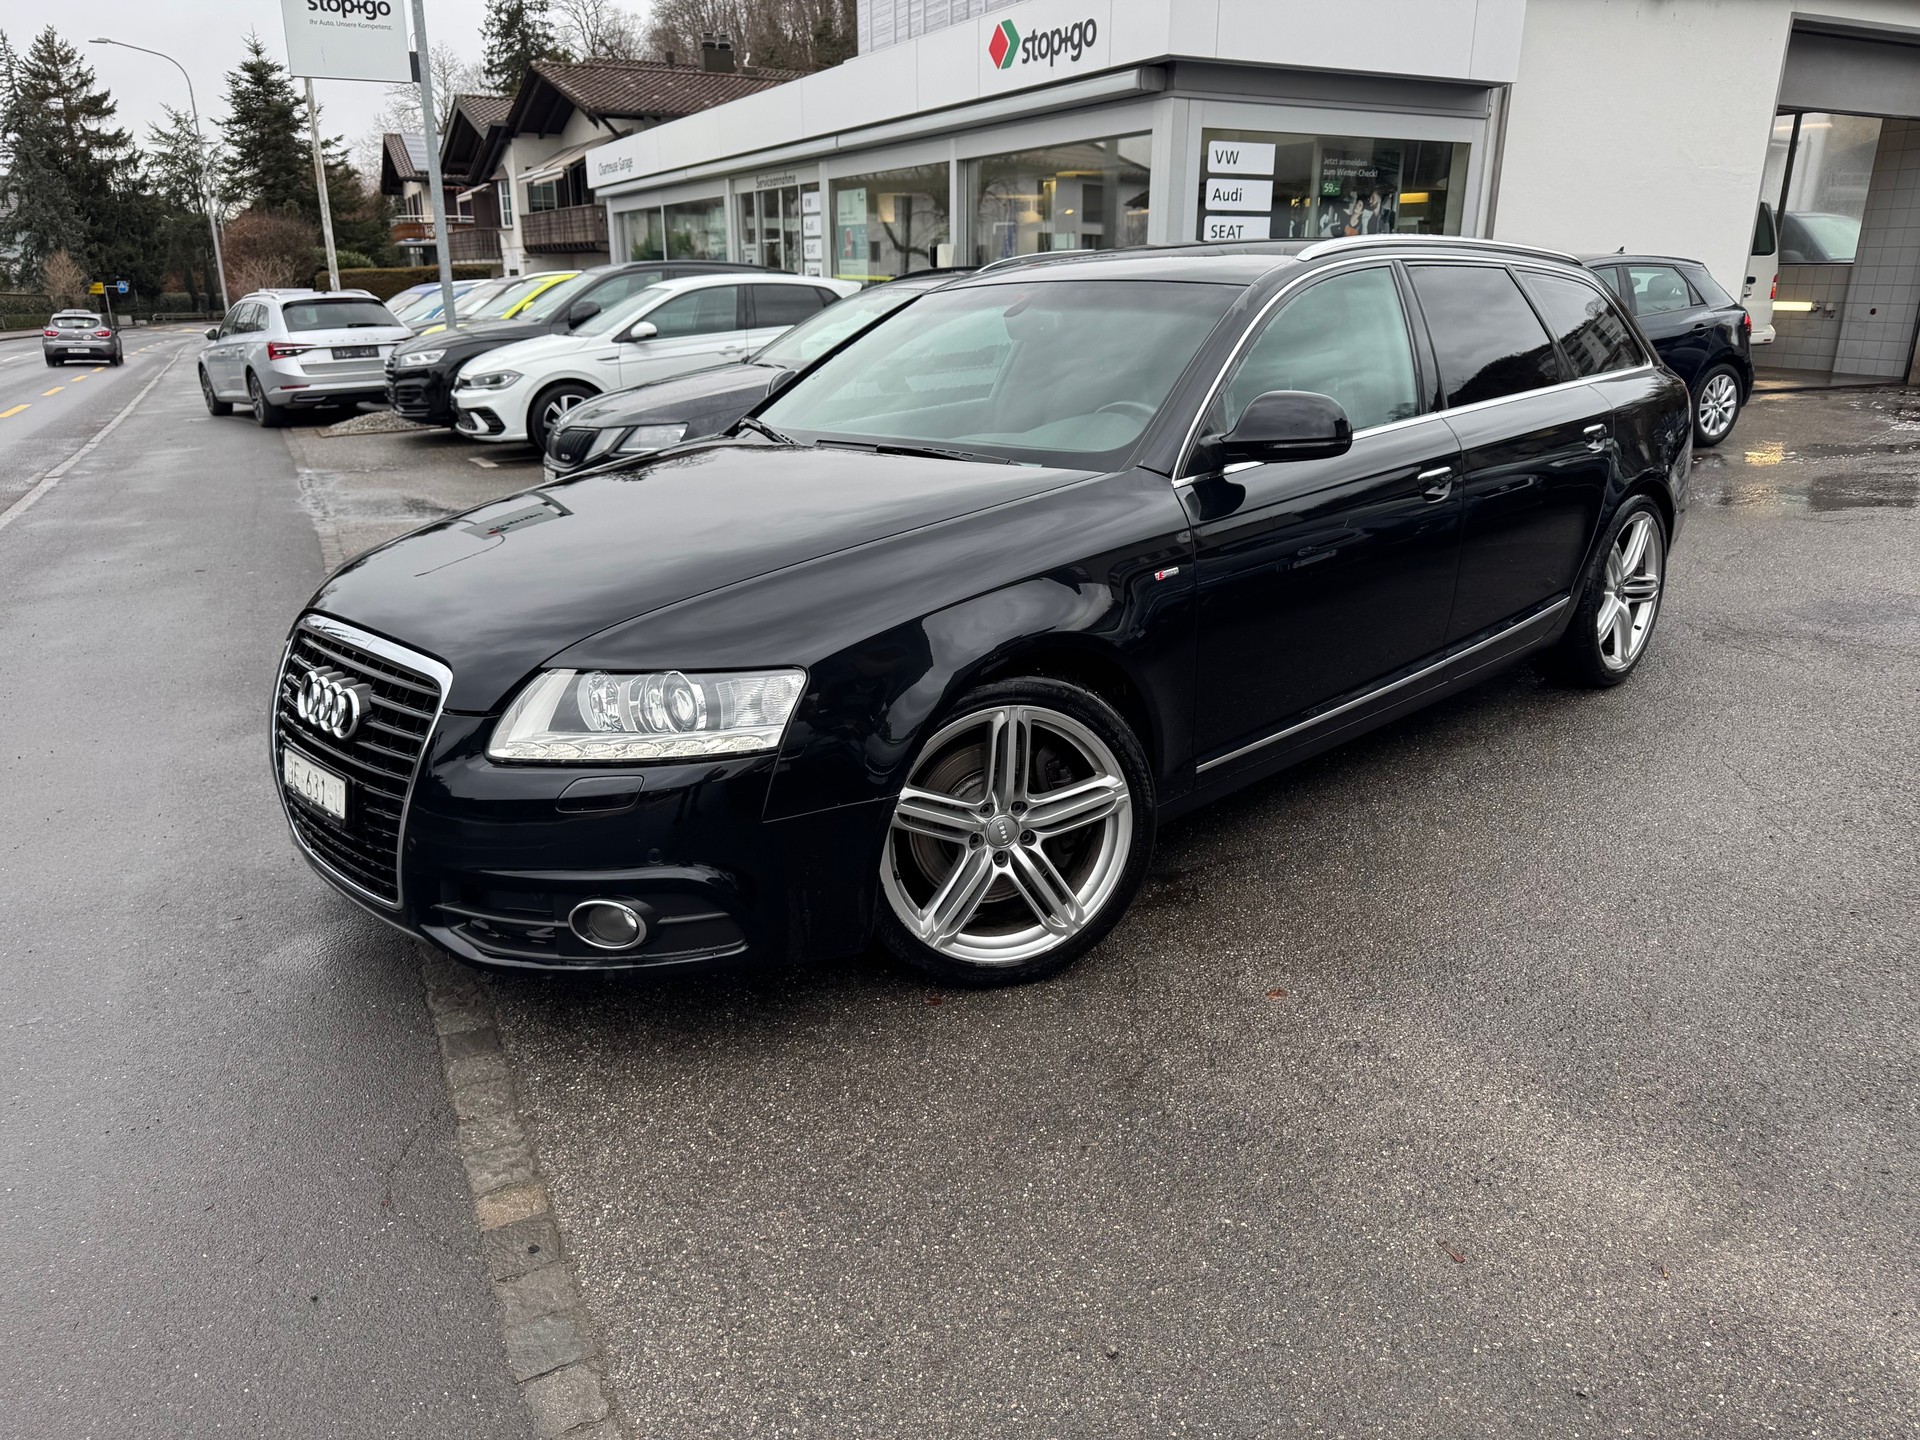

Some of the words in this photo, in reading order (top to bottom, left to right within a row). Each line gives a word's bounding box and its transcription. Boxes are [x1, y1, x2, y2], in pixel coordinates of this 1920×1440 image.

[319, 19, 335, 27] Auto.
[336, 20, 357, 28] Unsere
[358, 22, 393, 31] Kompetenz.
[1022, 18, 1097, 67] stop+go
[1215, 149, 1240, 165] VW
[1324, 157, 1338, 165] Jetzt
[1339, 158, 1368, 166] anmelden
[1337, 168, 1378, 178] Winter-Check!
[1212, 187, 1242, 202] Audi
[1210, 224, 1244, 239] SEAT
